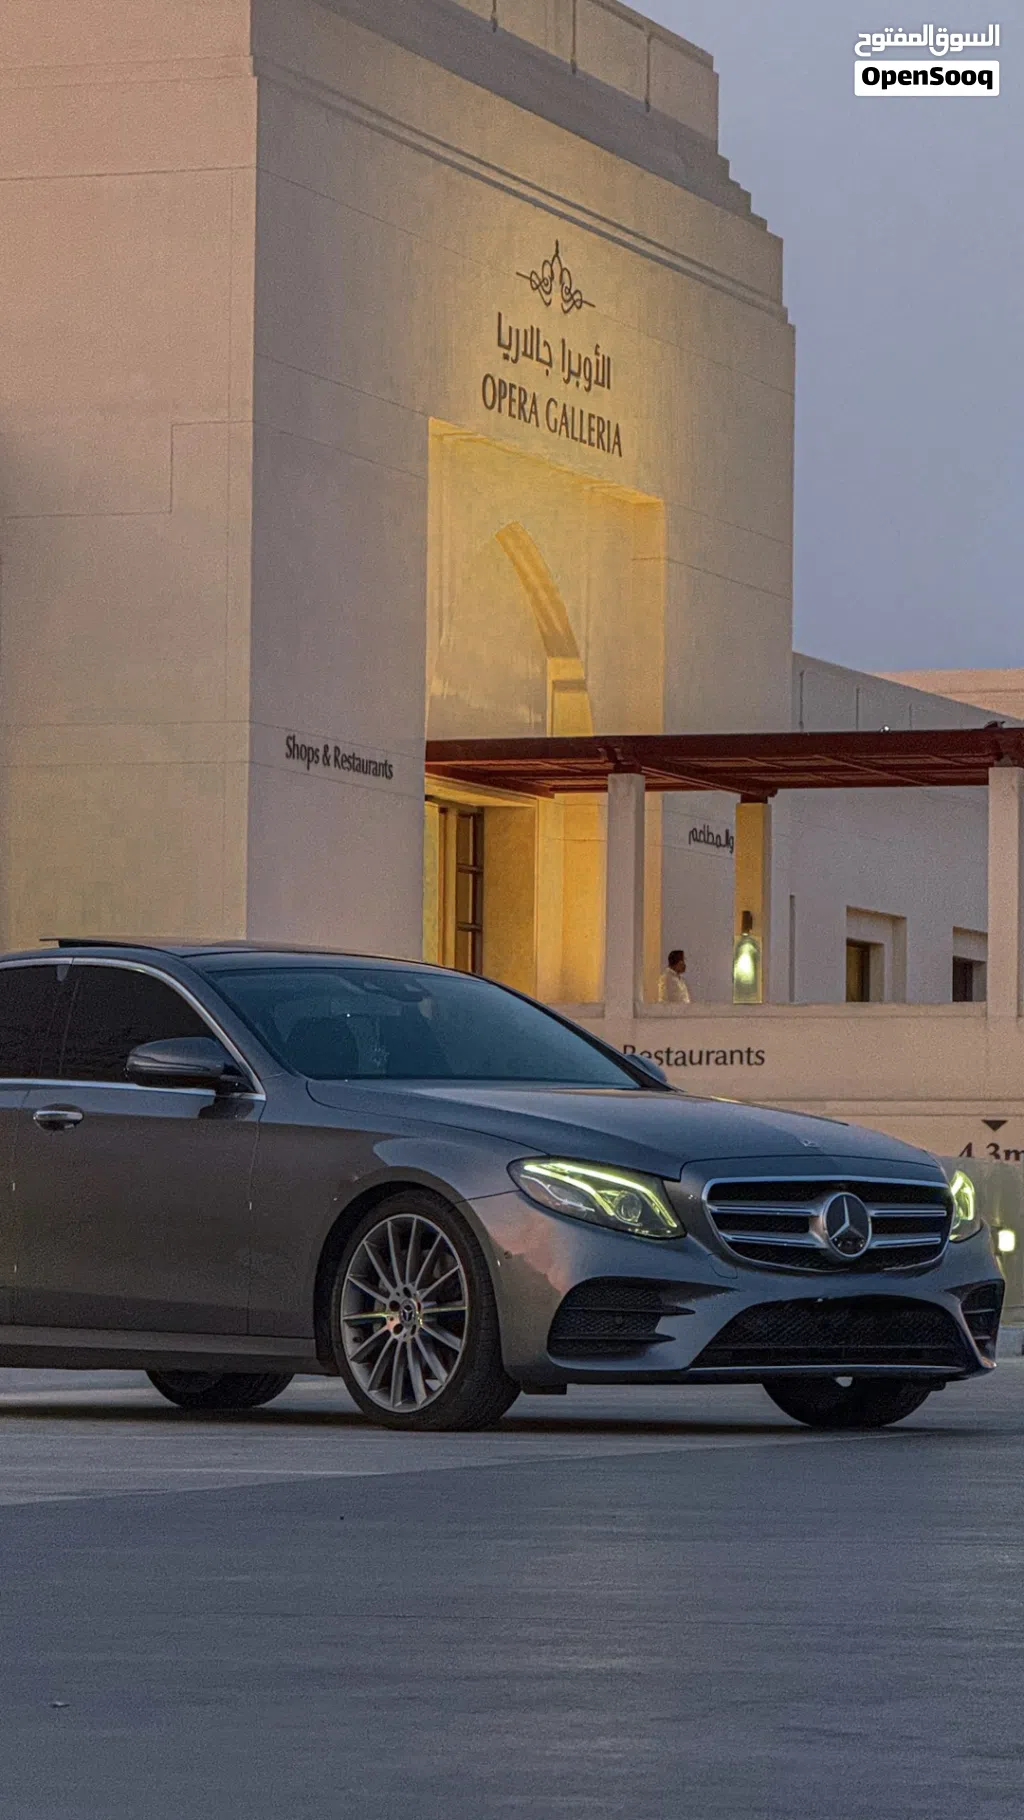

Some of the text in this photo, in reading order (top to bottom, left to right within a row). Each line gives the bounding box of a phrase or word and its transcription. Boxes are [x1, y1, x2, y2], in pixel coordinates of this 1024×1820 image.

[561, 337, 612, 393] الأوبرا
[481, 373, 623, 458] OPERA GALLERIA
[285, 734, 393, 780] Shops & Restaurants
